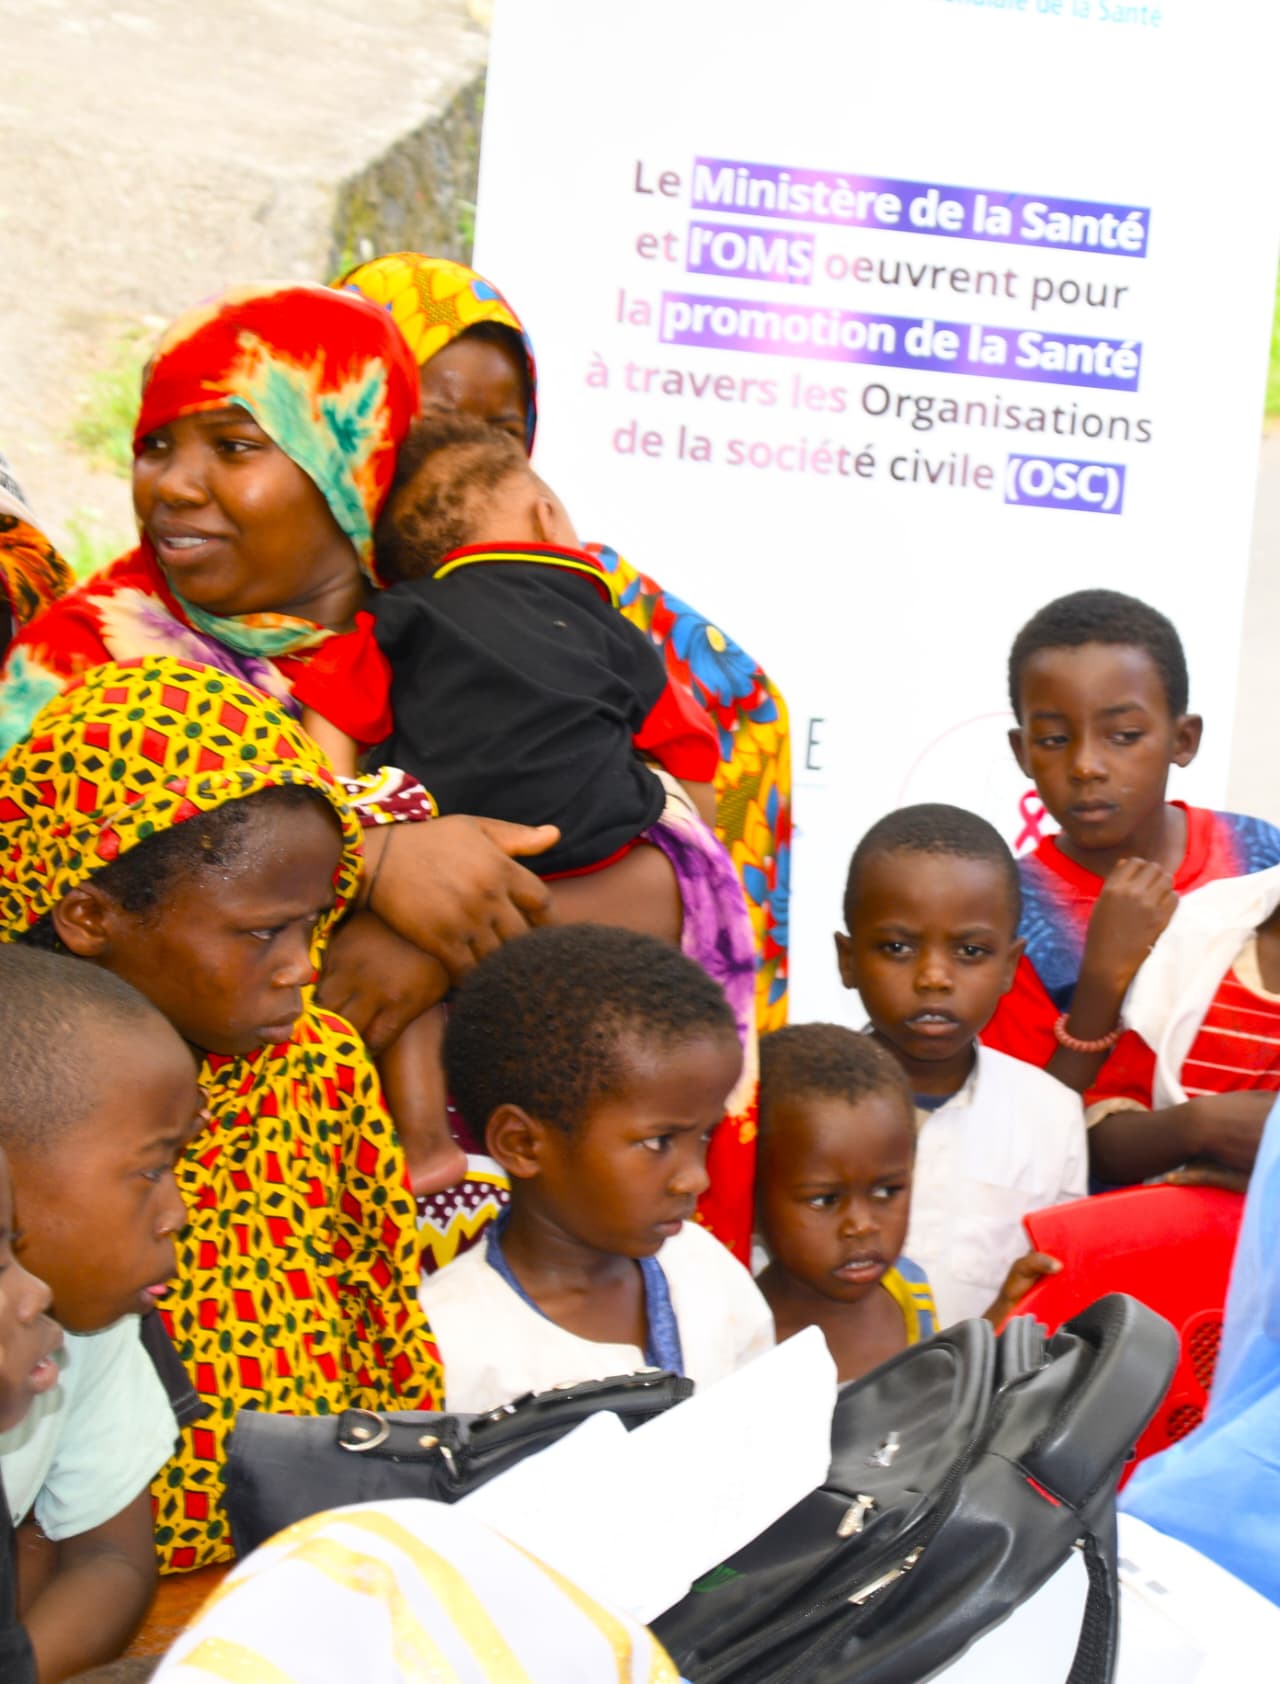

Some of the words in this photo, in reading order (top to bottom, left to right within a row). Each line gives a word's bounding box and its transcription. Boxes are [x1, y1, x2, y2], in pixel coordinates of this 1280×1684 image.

[633, 159, 682, 198] Le
[693, 164, 902, 224] Ministère
[908, 189, 965, 231] de
[972, 194, 1013, 236] la
[1020, 201, 1145, 250] Santé
[635, 231, 678, 262] et
[690, 226, 812, 278] l'OMS
[824, 253, 1018, 299] oeuvrent
[1031, 275, 1129, 311] pour
[616, 287, 652, 327] la
[663, 300, 897, 354] promotion
[904, 319, 960, 360] de
[967, 323, 1007, 365] la
[1014, 331, 1138, 379] Santé
[586, 351, 609, 389] à
[624, 360, 778, 408] travers
[790, 373, 848, 414] les
[861, 383, 1153, 444] Organisations
[611, 419, 664, 458] de
[678, 424, 713, 463] la
[725, 436, 876, 479] société
[889, 449, 996, 490] civile
[1005, 458, 1120, 510] (OSC)
